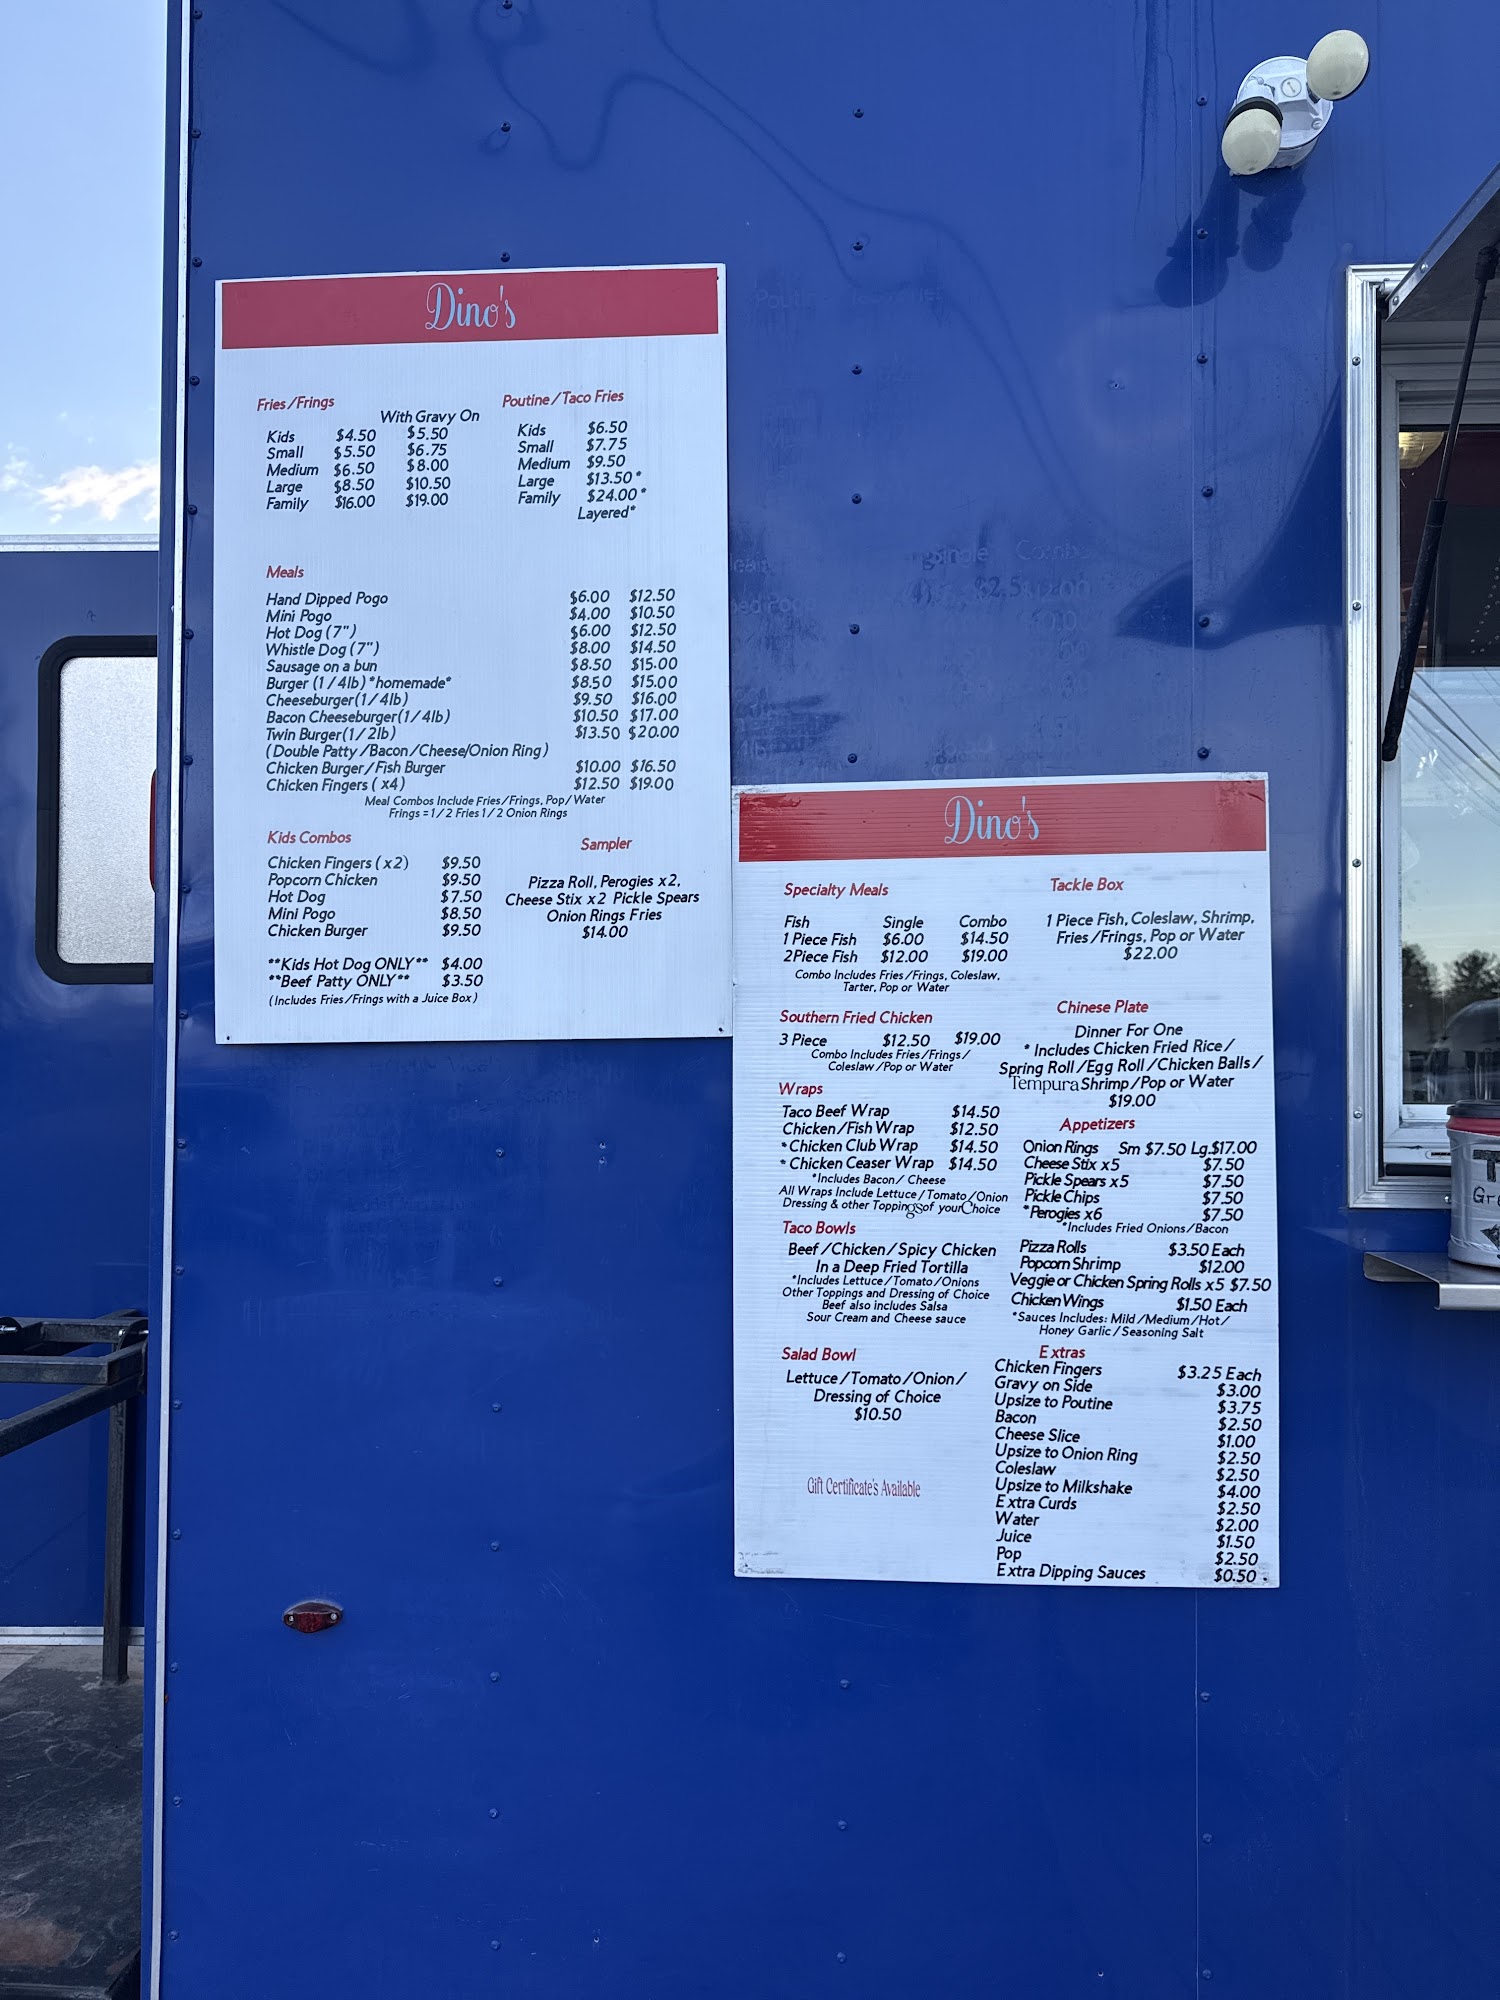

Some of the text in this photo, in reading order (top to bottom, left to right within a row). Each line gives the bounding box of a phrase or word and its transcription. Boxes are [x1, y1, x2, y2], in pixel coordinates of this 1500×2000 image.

[424, 281, 517, 332] Dino's
[381, 409, 480, 426] With Gravy On
[267, 425, 448, 443] Kids $4.50 $5.50
[517, 420, 628, 437] Kids $6.50
[266, 442, 447, 460] Small $5.50 $6.75
[518, 437, 627, 453] Small $7.75
[266, 458, 449, 477] Medium $6.50 $8.00
[518, 454, 625, 470] Medium $9.50
[266, 476, 451, 496] Large $8.50 $10.50
[518, 474, 555, 490] Large
[266, 492, 448, 512] Family $16.00 $19.00
[518, 491, 561, 507] Family
[266, 565, 304, 582] Meals
[266, 588, 675, 608] Hand Dipped Pogo $6.00 $12.50
[266, 605, 675, 626] Mini Pogo $4.00 $10.50
[266, 643, 315, 656] Whistle
[318, 643, 347, 659] Dog
[570, 641, 610, 655] $8.00
[630, 640, 676, 654] $14.50
[365, 795, 474, 806] Meal Combos Include
[506, 807, 567, 820] Onion Rings
[945, 795, 1041, 845] Dino's
[267, 831, 351, 847] Kids Combos
[581, 837, 633, 852] Sampler
[268, 873, 481, 889] Popcorn Chicken $9.50
[1051, 877, 1124, 891] Tackle Box
[784, 883, 889, 899] Specialty Meals
[547, 907, 662, 925] Onion Rings Fries
[784, 914, 1007, 932] Fish Single Combo
[1047, 914, 1052, 927] 1
[1056, 913, 1094, 927] Piece
[268, 923, 481, 940] Chicken Burger $9.50
[582, 924, 628, 940] $14.00
[882, 931, 1009, 946] $6.00 $14.50
[1123, 946, 1178, 961] $22.00
[879, 982, 899, 994] Pop
[917, 981, 950, 992] Water
[1057, 1000, 1149, 1016] Chinese Plate
[780, 1010, 932, 1026] Southern Fried Chicken
[1074, 1023, 1183, 1038] Dinner For One
[779, 1031, 1001, 1048] 3 Piece $12.50 $19.00
[779, 1082, 823, 1097] Wraps
[1108, 1093, 1156, 1108] $19.00
[782, 1103, 1000, 1119] Taco Beef Wrap $14.50
[1059, 1118, 1135, 1133] Appetizers
[1024, 1188, 1243, 1206] Pickle Chips $7.50
[782, 1220, 856, 1235] Taco Bowls
[816, 1258, 968, 1276] In a Deep Fried Tortilla
[822, 1300, 948, 1311] Beef also includes Salsa
[781, 1347, 856, 1361] Salad Bowl
[995, 1375, 1261, 1398] Gravy on Side $3.00
[814, 1388, 941, 1406] Dressing of Choice
[995, 1392, 1262, 1415] Upsize to Poutine $3.75
[854, 1406, 902, 1421] $10.50
[995, 1409, 1262, 1431] Bacon $2.50
[995, 1427, 1256, 1448] Cheese Slice $1.00
[808, 1477, 920, 1497] Gift Certificate's Available
[995, 1478, 1261, 1499] Upsize to Milkshake $4.00
[996, 1528, 1255, 1549] Juice $1.50
[997, 1546, 1258, 1566] Pop $2.50
[1039, 1563, 1258, 1585] Dipping Sauces $0.50
